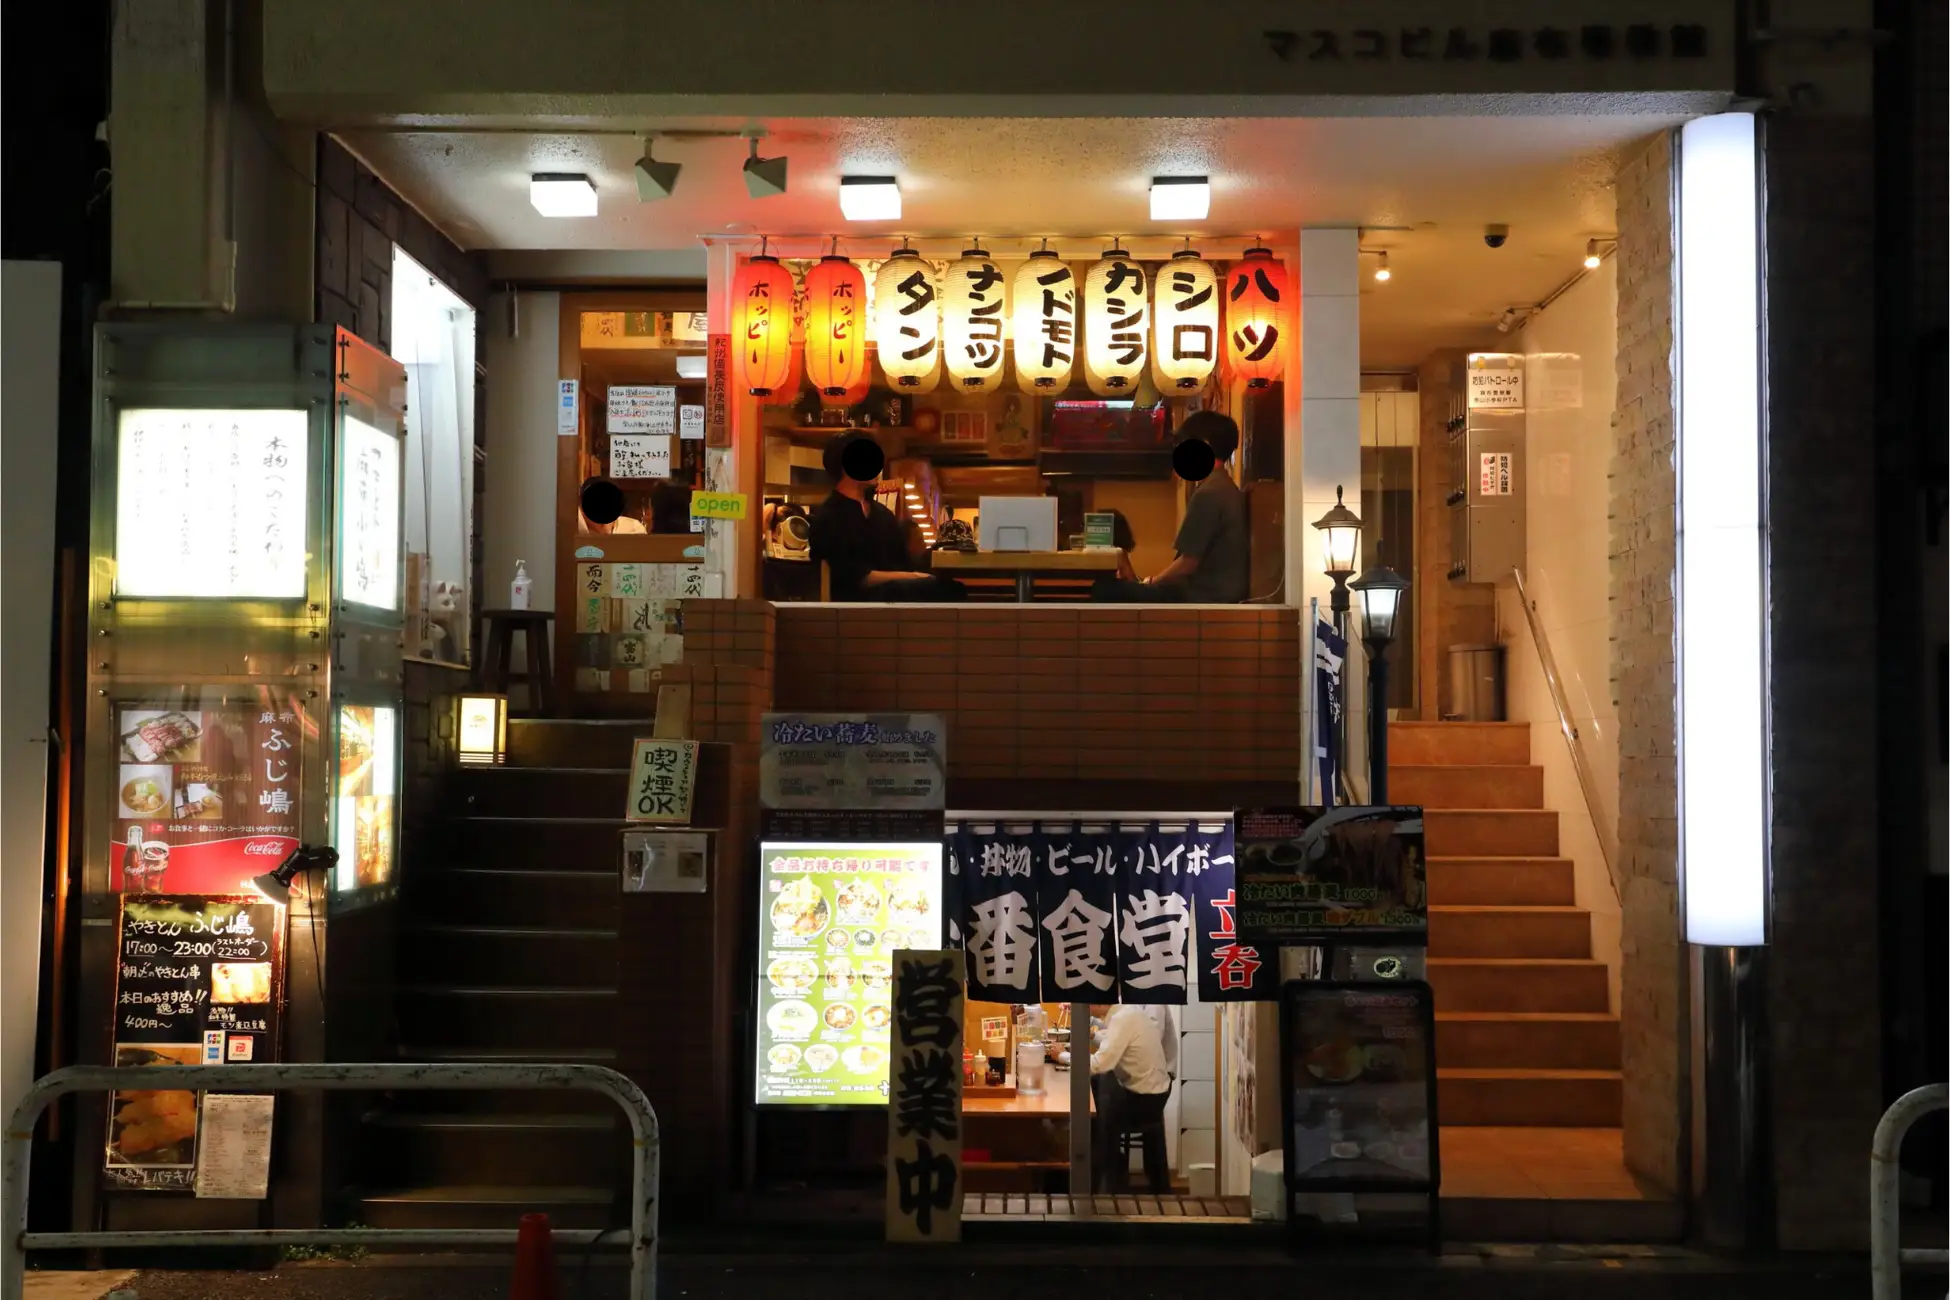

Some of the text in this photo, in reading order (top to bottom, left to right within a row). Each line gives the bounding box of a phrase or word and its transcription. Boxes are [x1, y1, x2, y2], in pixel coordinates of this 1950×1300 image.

[748, 281, 769, 364] ホッピー
[833, 281, 852, 364] ホッピー
[897, 271, 935, 361] タン
[965, 264, 1004, 369] ナンコツ
[1037, 267, 1074, 368] ノドモト
[1103, 262, 1144, 365] カシラ
[1173, 271, 1213, 362] シロ
[1231, 268, 1280, 361] ハツ
[697, 497, 740, 512] open
[259, 711, 296, 724] 麻布
[259, 728, 294, 816] ふじ嶋
[128, 911, 254, 936] やきとん ふじ嶋
[950, 889, 1190, 991] 番食堂
[897, 957, 962, 1236] 営業中
